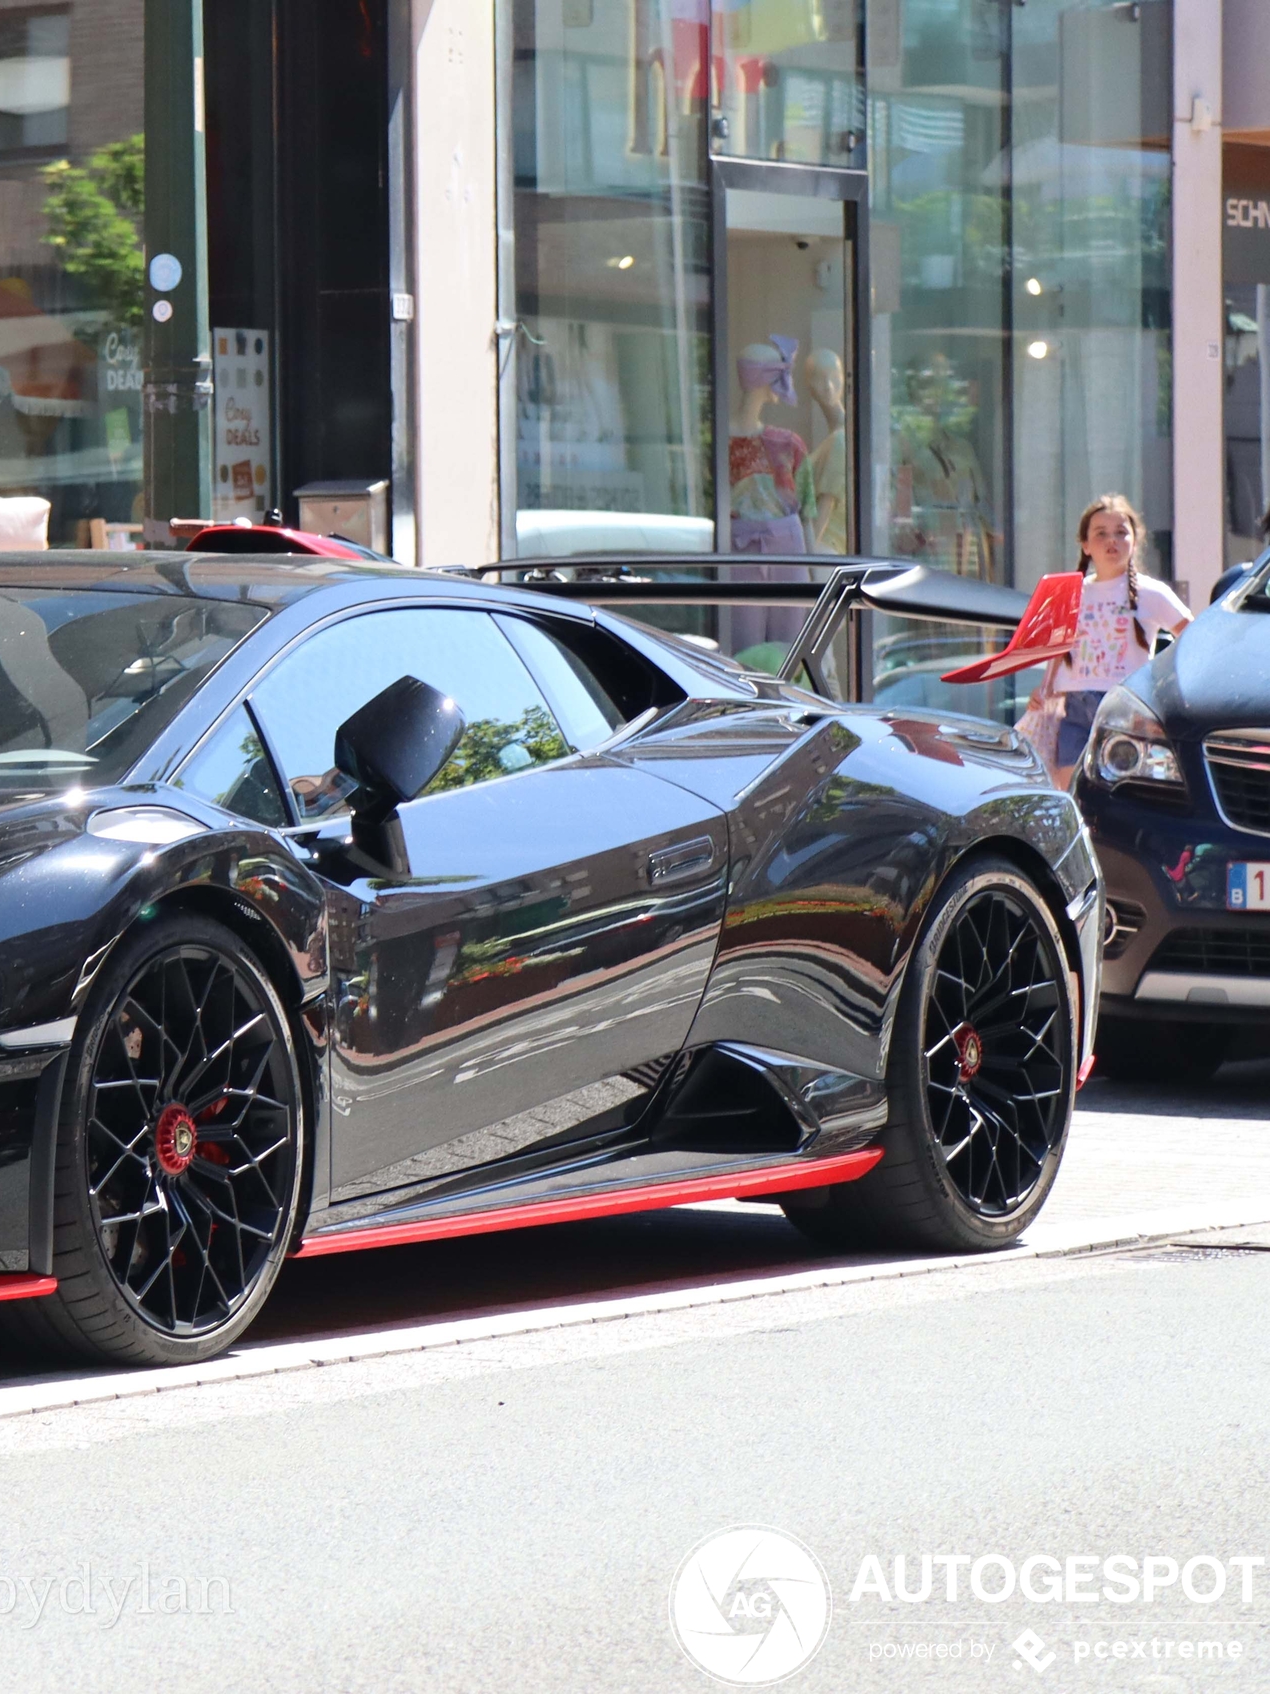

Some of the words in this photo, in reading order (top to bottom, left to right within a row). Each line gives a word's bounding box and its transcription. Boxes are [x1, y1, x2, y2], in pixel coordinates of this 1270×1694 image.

[226, 429, 260, 446] DEALS
[1254, 869, 1264, 901] 1
[1232, 888, 1243, 904] B
